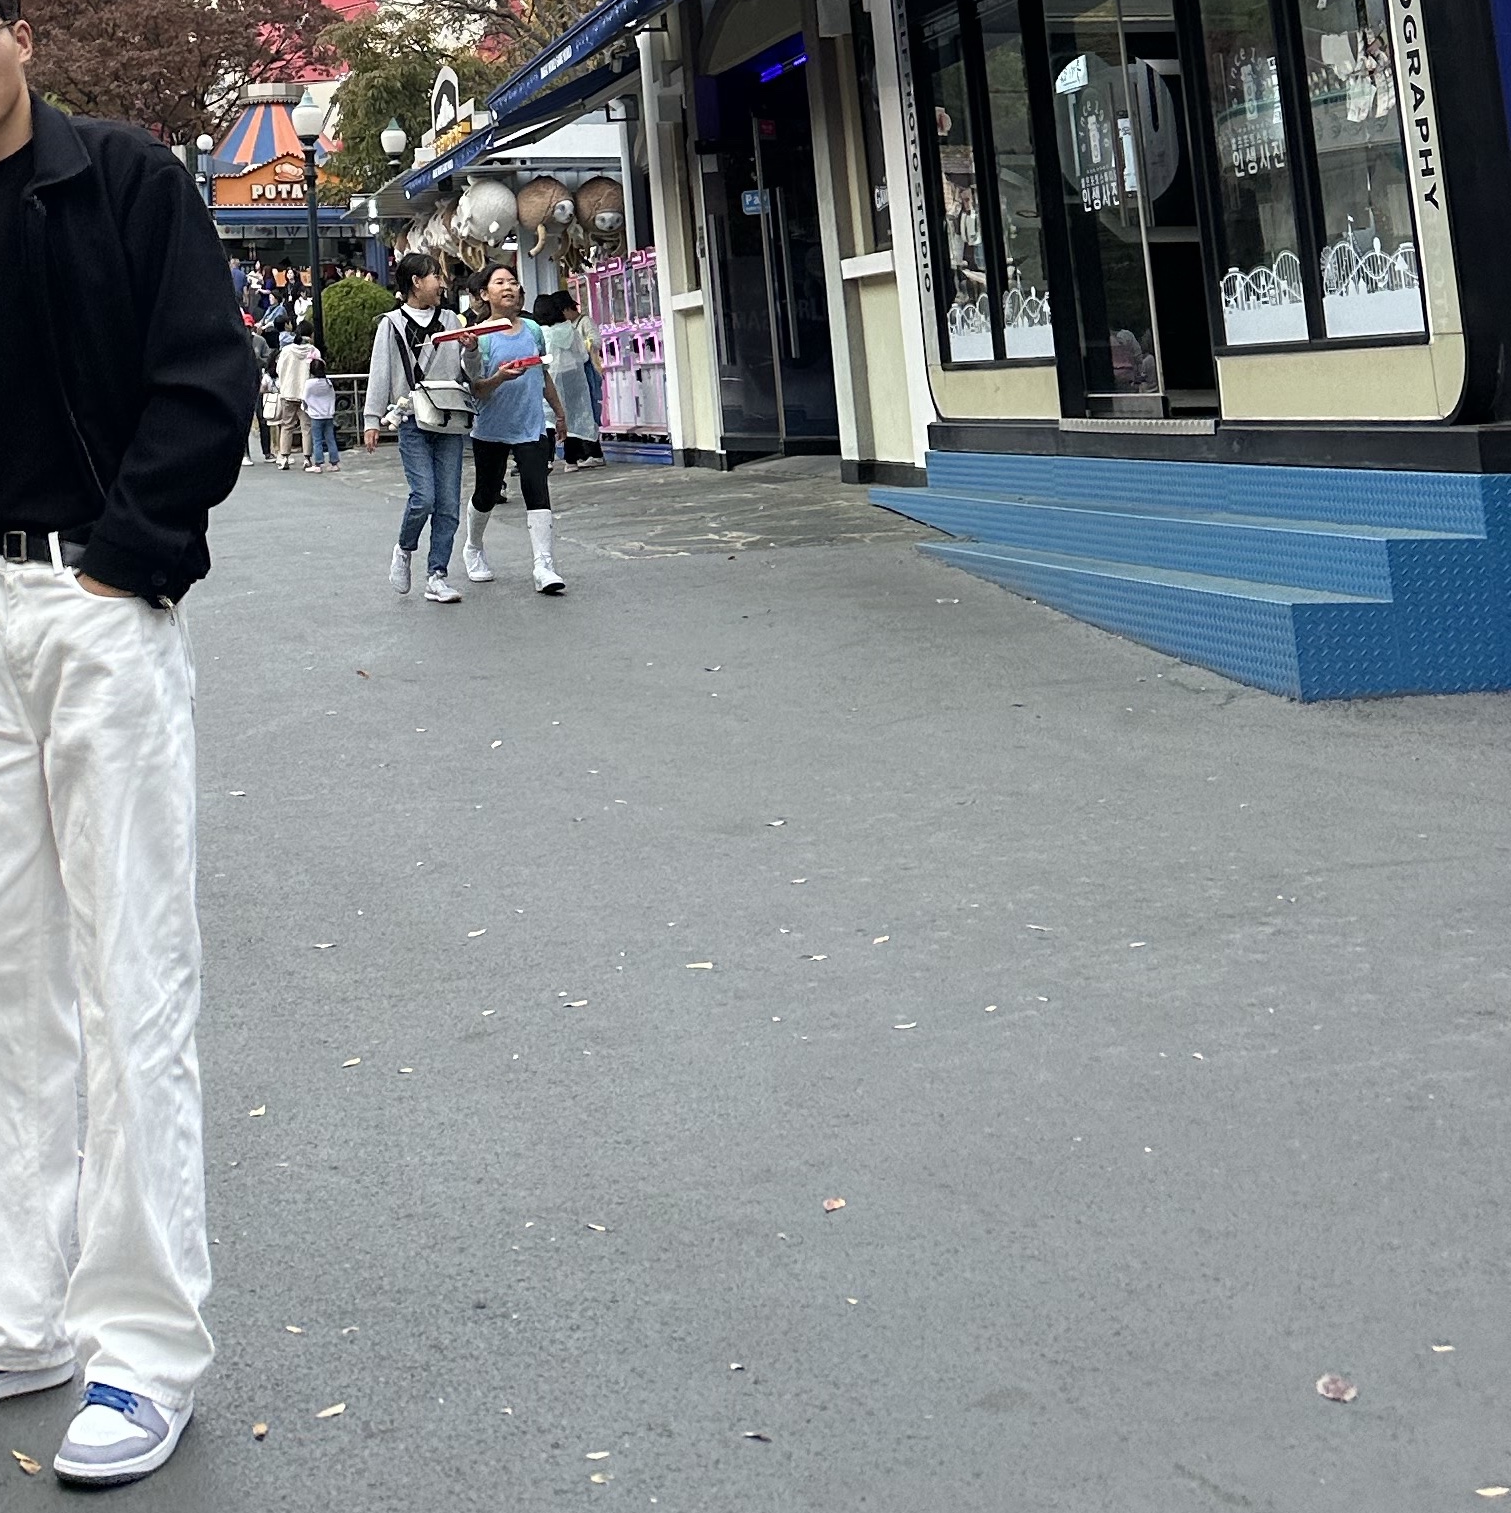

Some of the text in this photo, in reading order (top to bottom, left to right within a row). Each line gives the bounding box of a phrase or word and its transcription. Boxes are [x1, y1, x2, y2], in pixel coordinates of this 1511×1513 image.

[1232, 140, 1286, 178] 인생사진
[904, 71, 919, 172] PHOTO
[913, 181, 932, 293] STUDIO
[1081, 181, 1120, 213] 인생사진
